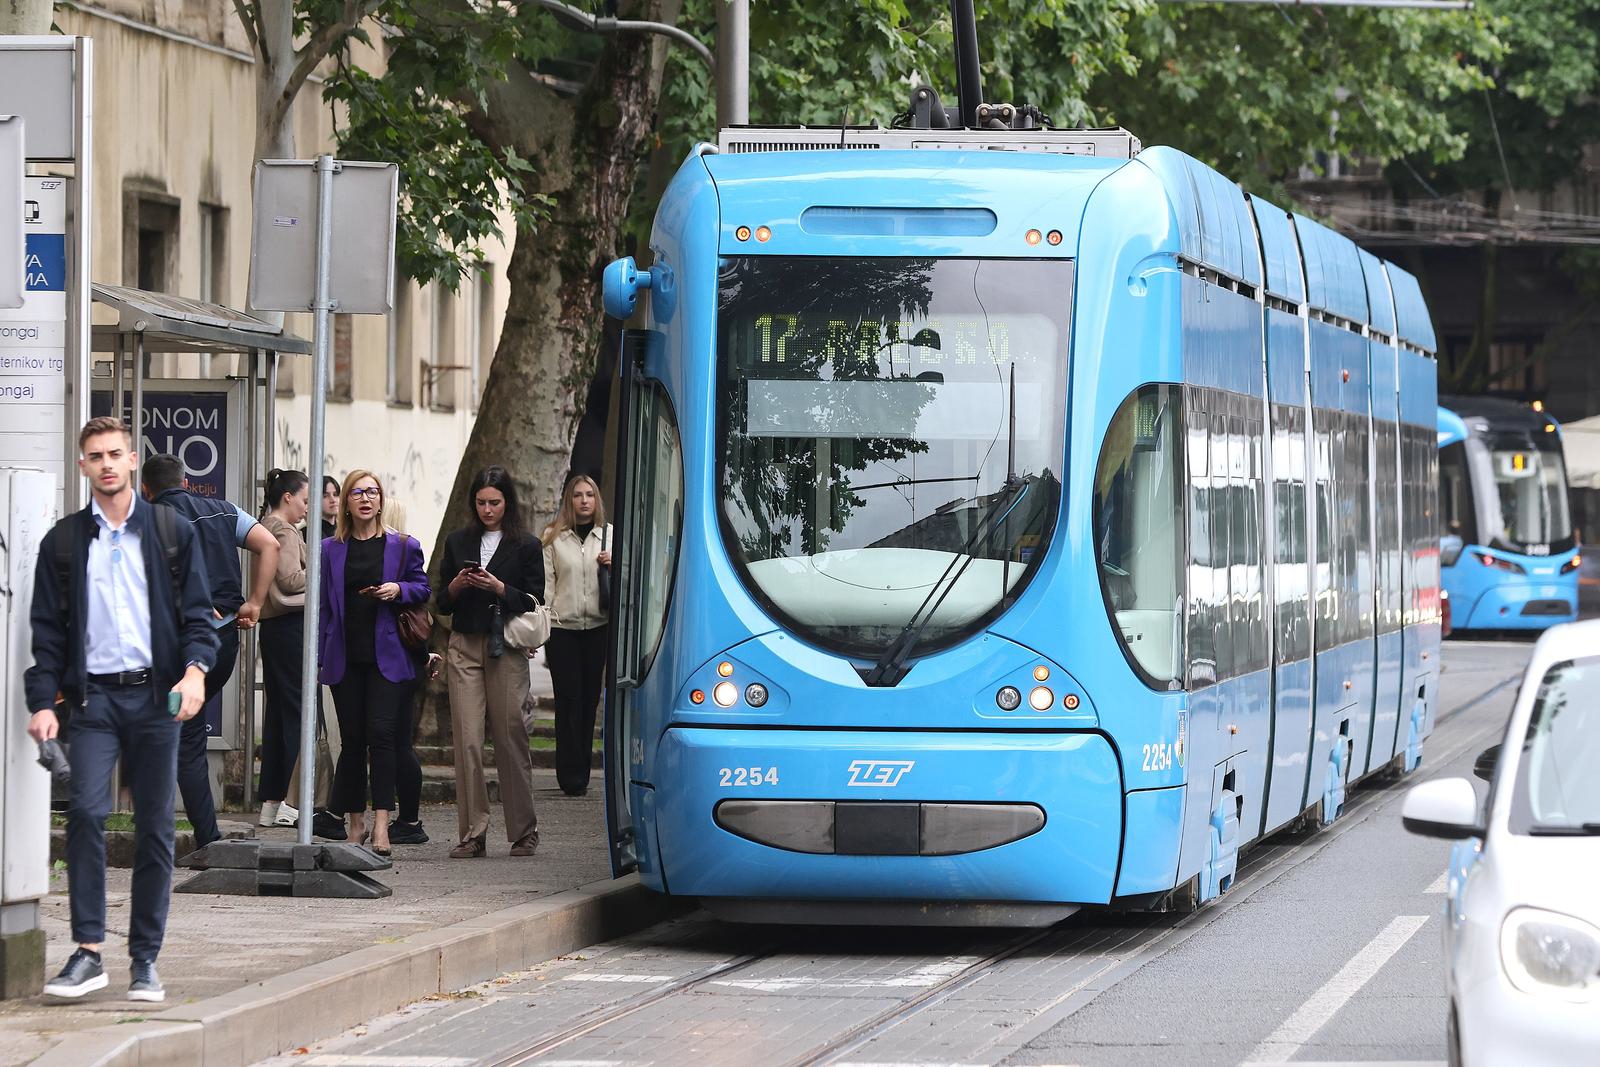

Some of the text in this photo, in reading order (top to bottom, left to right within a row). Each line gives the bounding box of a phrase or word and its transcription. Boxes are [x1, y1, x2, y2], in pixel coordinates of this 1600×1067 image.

[0, 326, 39, 341] ongaj
[755, 314, 797, 363] 17
[48, 357, 63, 372] trg
[1142, 743, 1172, 772] 2254
[719, 766, 779, 787] 2254
